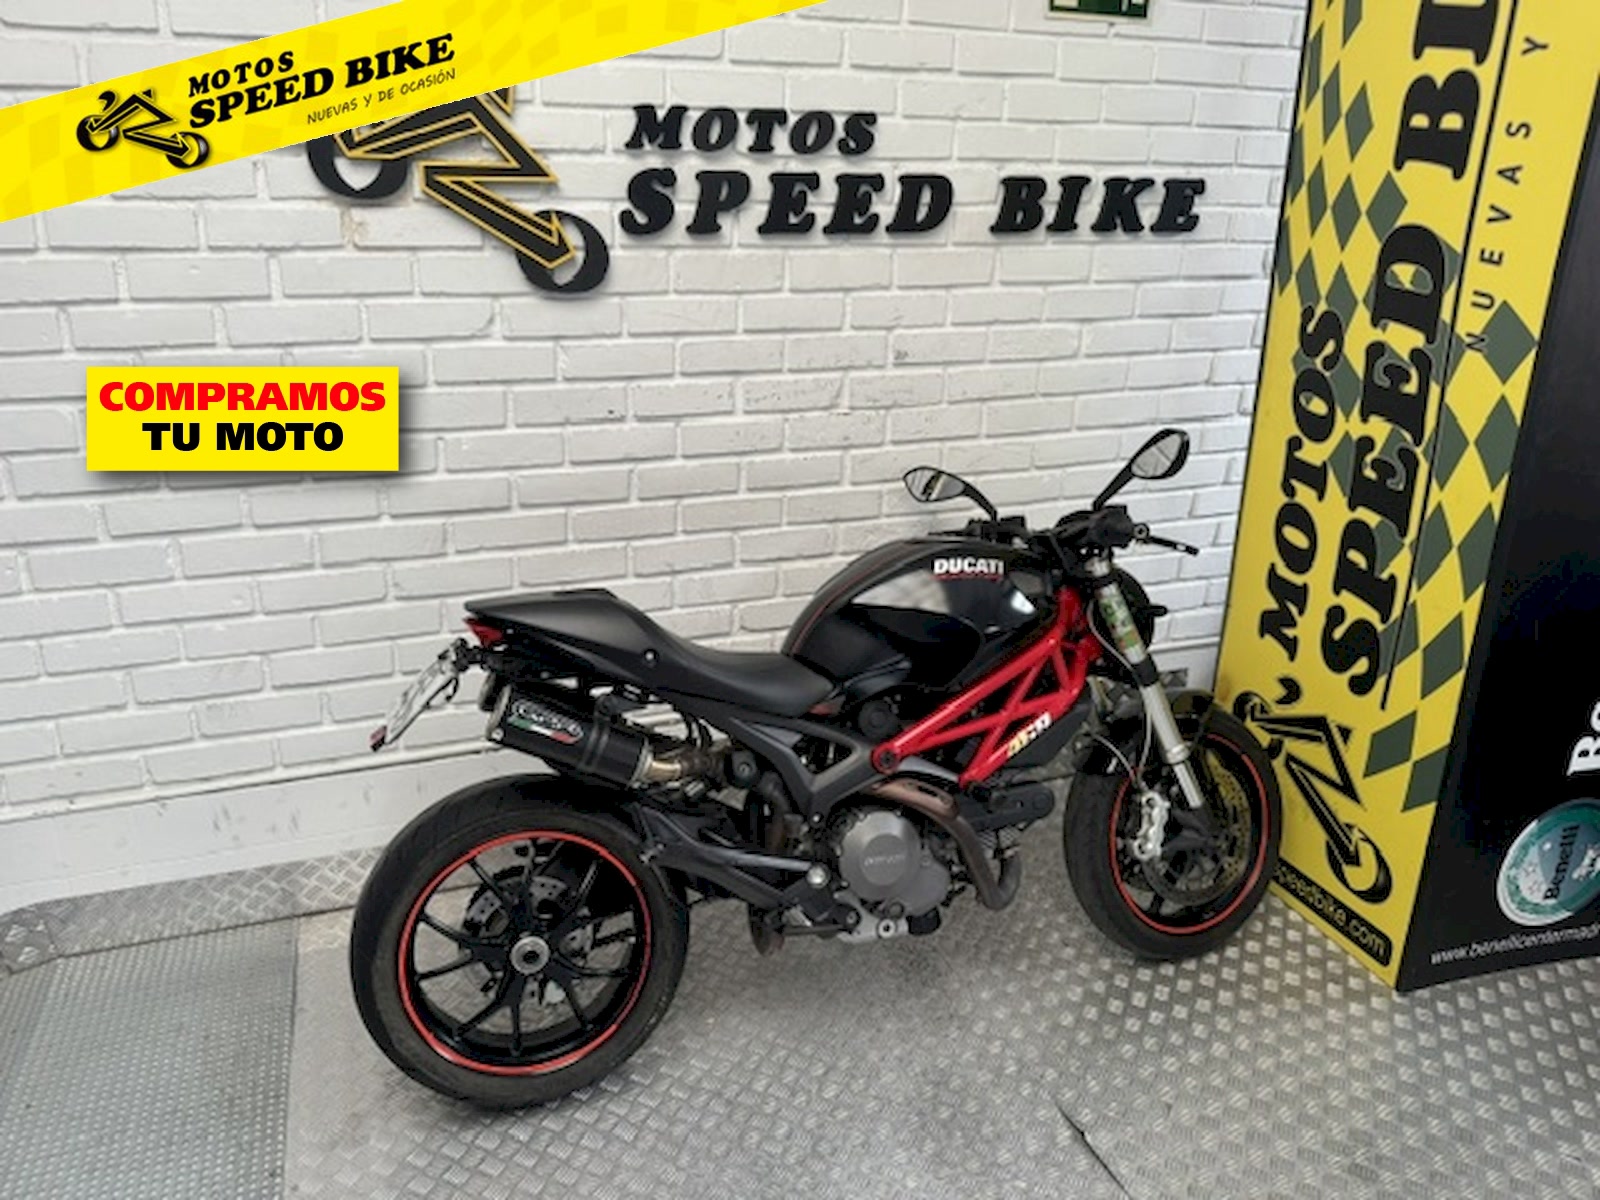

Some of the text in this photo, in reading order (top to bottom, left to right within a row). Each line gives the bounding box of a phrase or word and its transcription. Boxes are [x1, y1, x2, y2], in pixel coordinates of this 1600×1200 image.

[618, 168, 1205, 237] SPEED BIKE
[624, 105, 877, 156] MOTOS
[1464, 36, 1549, 352] NUEVAS Y
[1259, 304, 1344, 663] MOTOS
[1320, 223, 1446, 697] SPEED
[933, 556, 1005, 575] DUCATI
